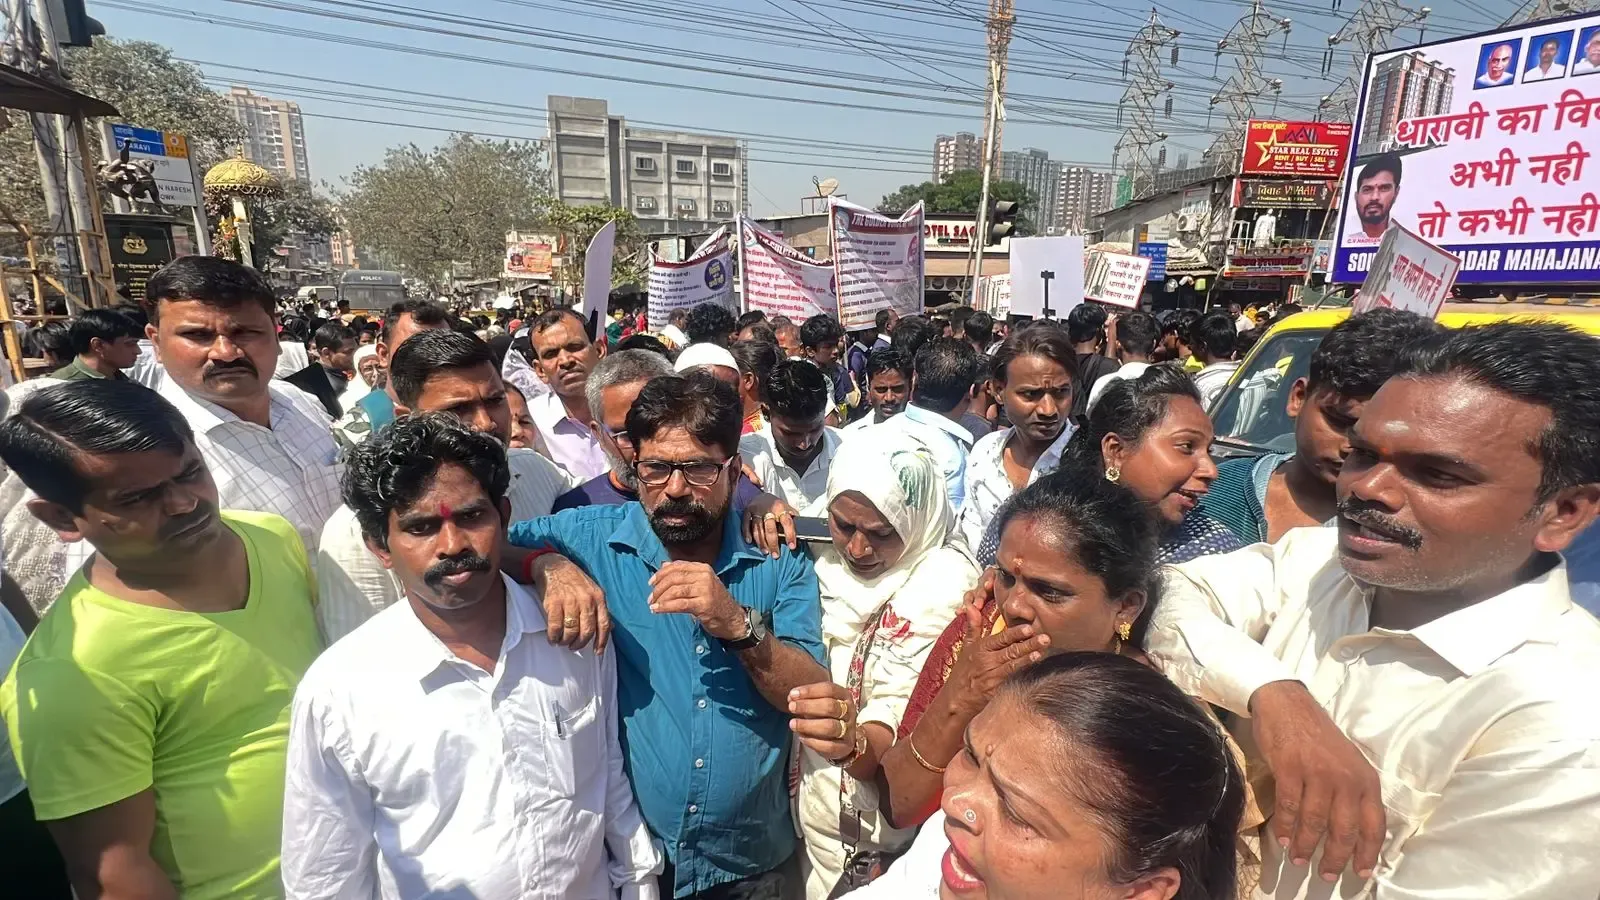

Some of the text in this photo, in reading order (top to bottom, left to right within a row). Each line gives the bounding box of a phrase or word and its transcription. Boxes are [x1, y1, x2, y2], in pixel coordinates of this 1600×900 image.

[1396, 89, 1600, 145] धारावी का वि
[117, 140, 151, 152] DARAVI
[1269, 146, 1339, 157] STAR REAL ESTATE
[1450, 141, 1590, 188] अभी नही
[1418, 201, 1451, 238] तो
[1457, 196, 1534, 236] कभी
[924, 225, 949, 237] OTEL
[1450, 249, 1501, 271] ADAR
